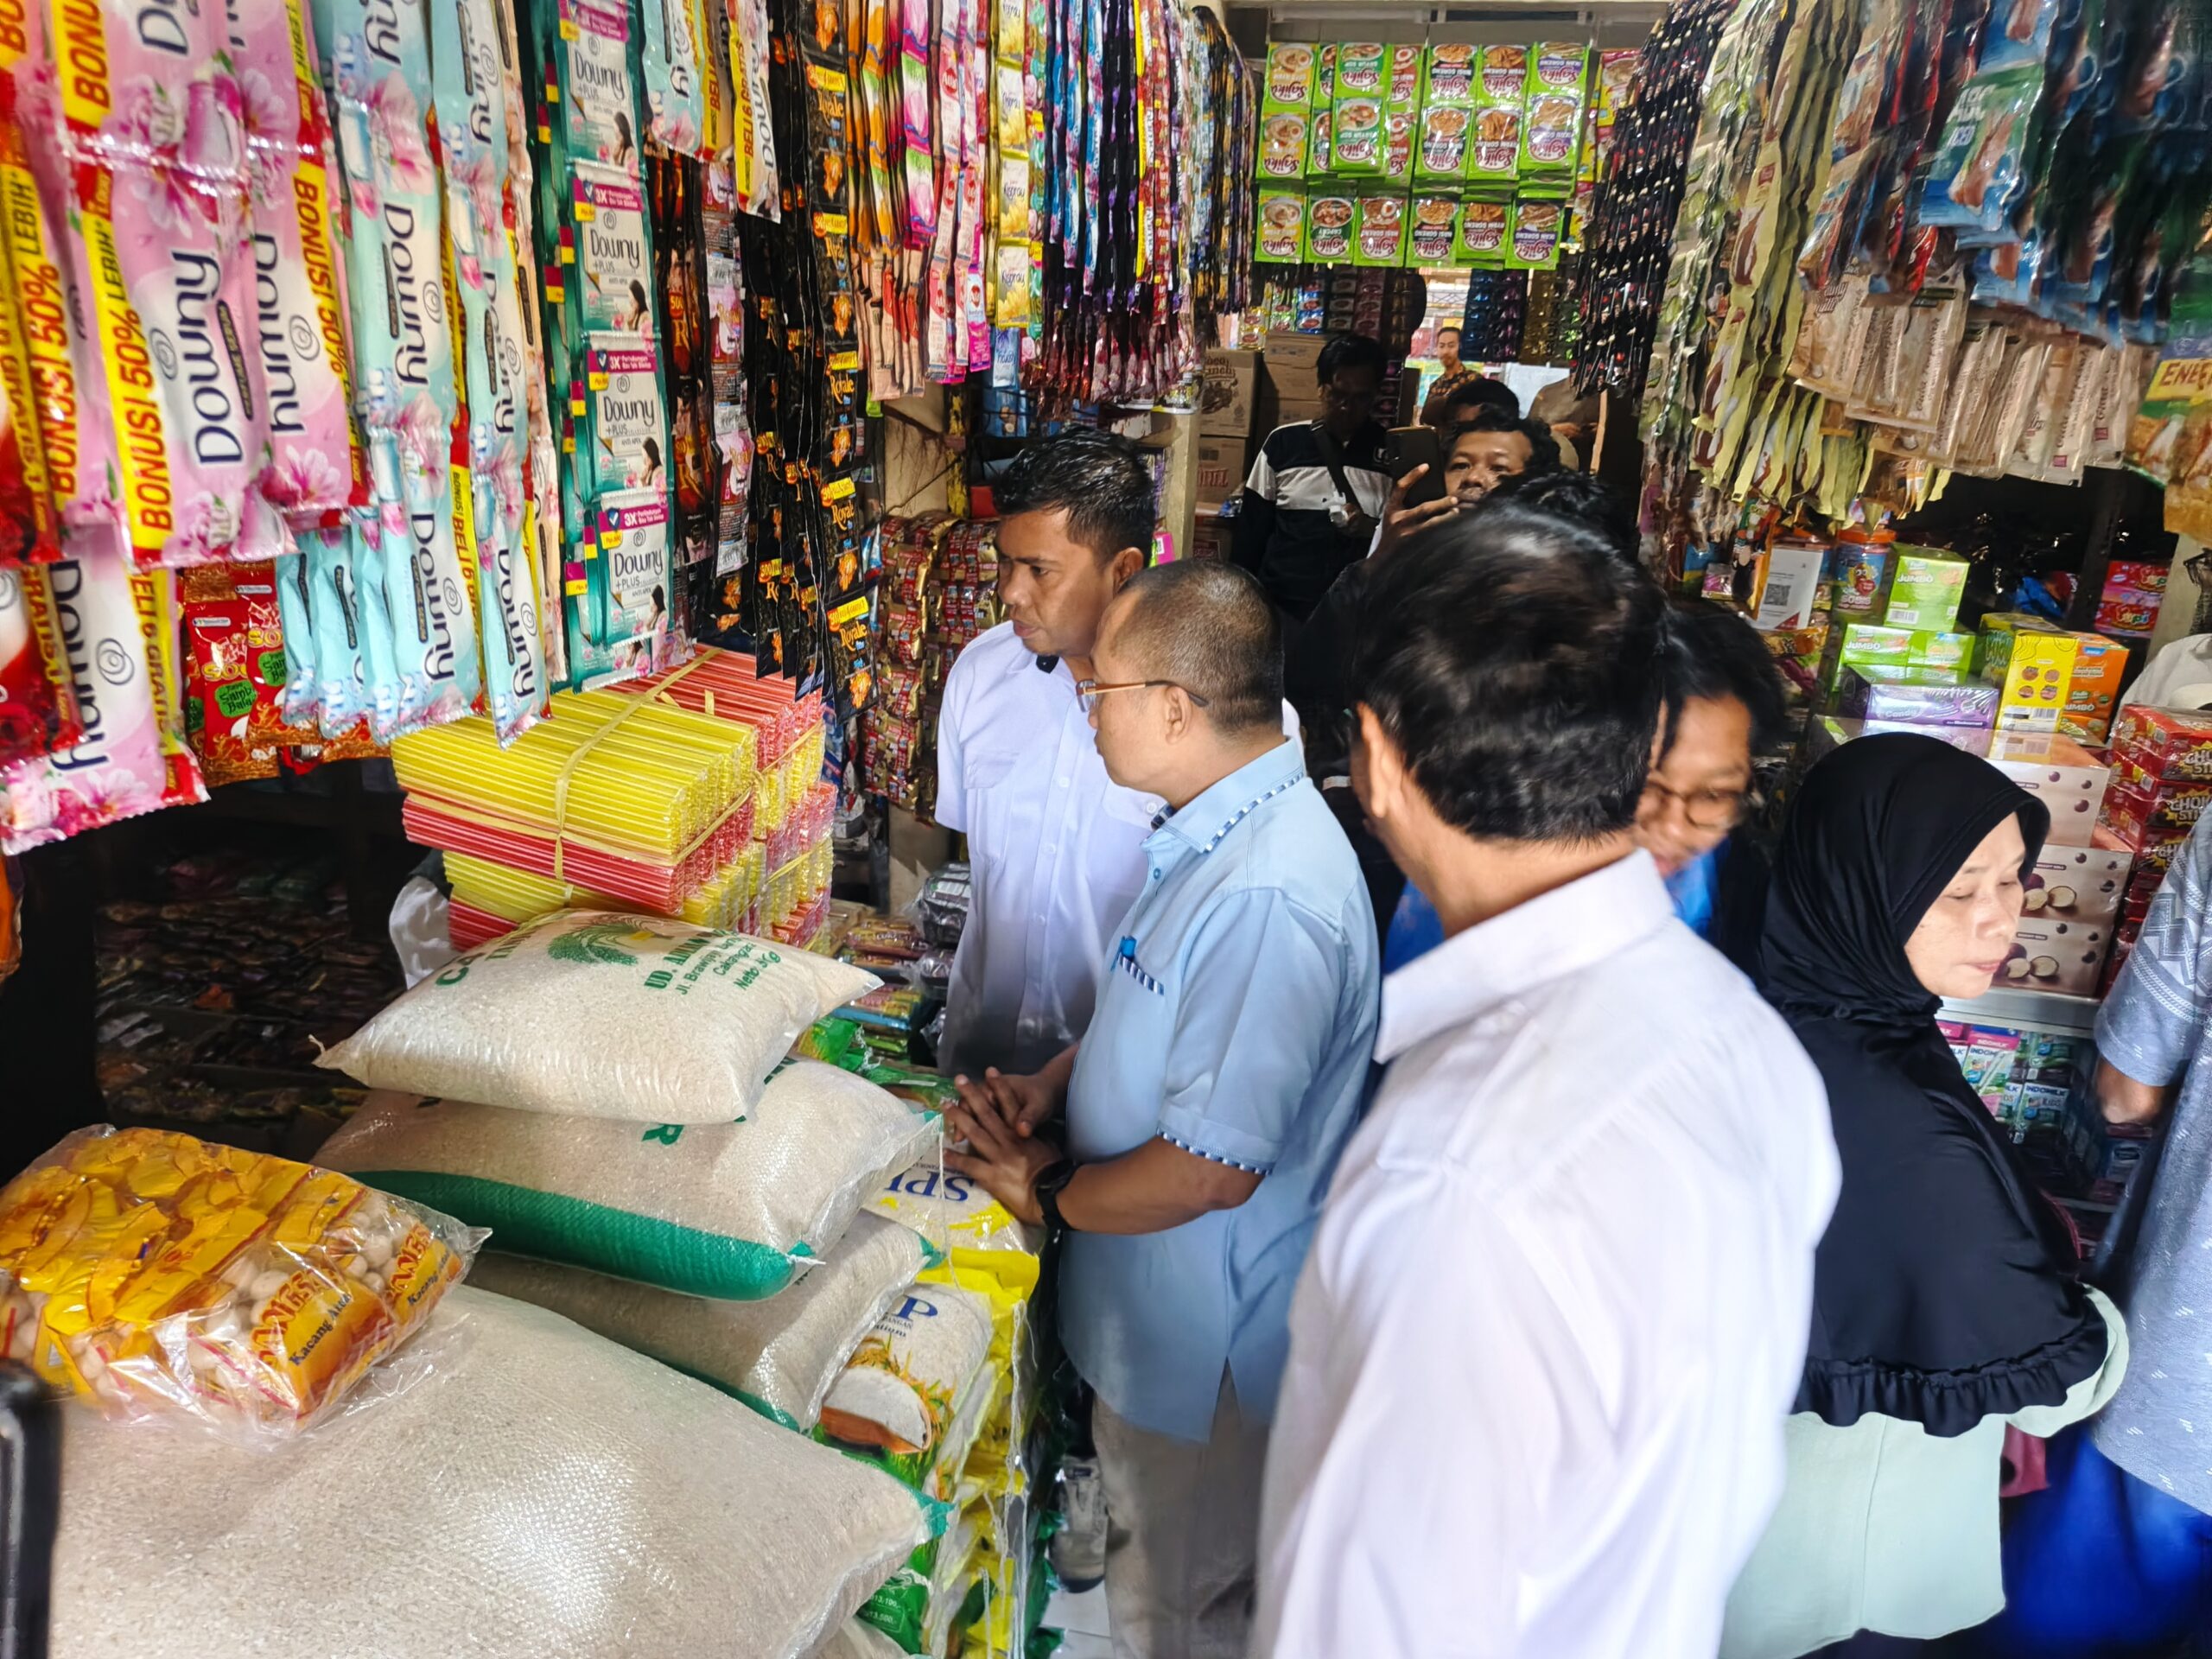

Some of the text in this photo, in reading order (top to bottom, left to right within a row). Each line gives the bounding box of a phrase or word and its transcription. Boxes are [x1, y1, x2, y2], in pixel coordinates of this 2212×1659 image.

[575, 48, 625, 101] Downy
[1342, 68, 1379, 85] Sajiku
[1484, 75, 1522, 92] Sajiku
[1540, 66, 1579, 83] Sajiku
[1271, 80, 1307, 99] Sajiku
[1431, 76, 1470, 94] Sajiku
[1338, 138, 1376, 156] Sajiku
[1475, 147, 1513, 165] Sajiku
[1530, 139, 1568, 156] Sajiku
[1264, 155, 1300, 173] Sajiku
[590, 228, 640, 269] Downy
[1262, 236, 1298, 253] Sajiku
[1313, 236, 1349, 253] Sajiku
[1414, 238, 1452, 257] Sajiku
[1465, 230, 1503, 248] Sajiku
[1514, 242, 1553, 261] Sajiku
[294, 178, 346, 374] BONUS! 50%
[384, 202, 429, 385] Downy
[22, 263, 69, 347] 50%
[111, 307, 156, 391] 50%
[171, 250, 244, 465] Downy
[830, 372, 855, 404] Royale
[603, 396, 655, 427] Downy
[124, 397, 173, 533] BONUS!
[624, 512, 639, 527] 3X
[453, 516, 474, 564] BELI
[614, 549, 664, 577] Downy
[615, 575, 640, 589] +PLUS
[1897, 573, 1935, 583] JUMBO
[411, 513, 456, 682] Downy
[839, 620, 868, 652] Royale
[1845, 641, 1881, 650] JUMBO
[2064, 702, 2095, 711] UMBO
[734, 965, 760, 990] Netto
[289, 1319, 334, 1367] Kacang
